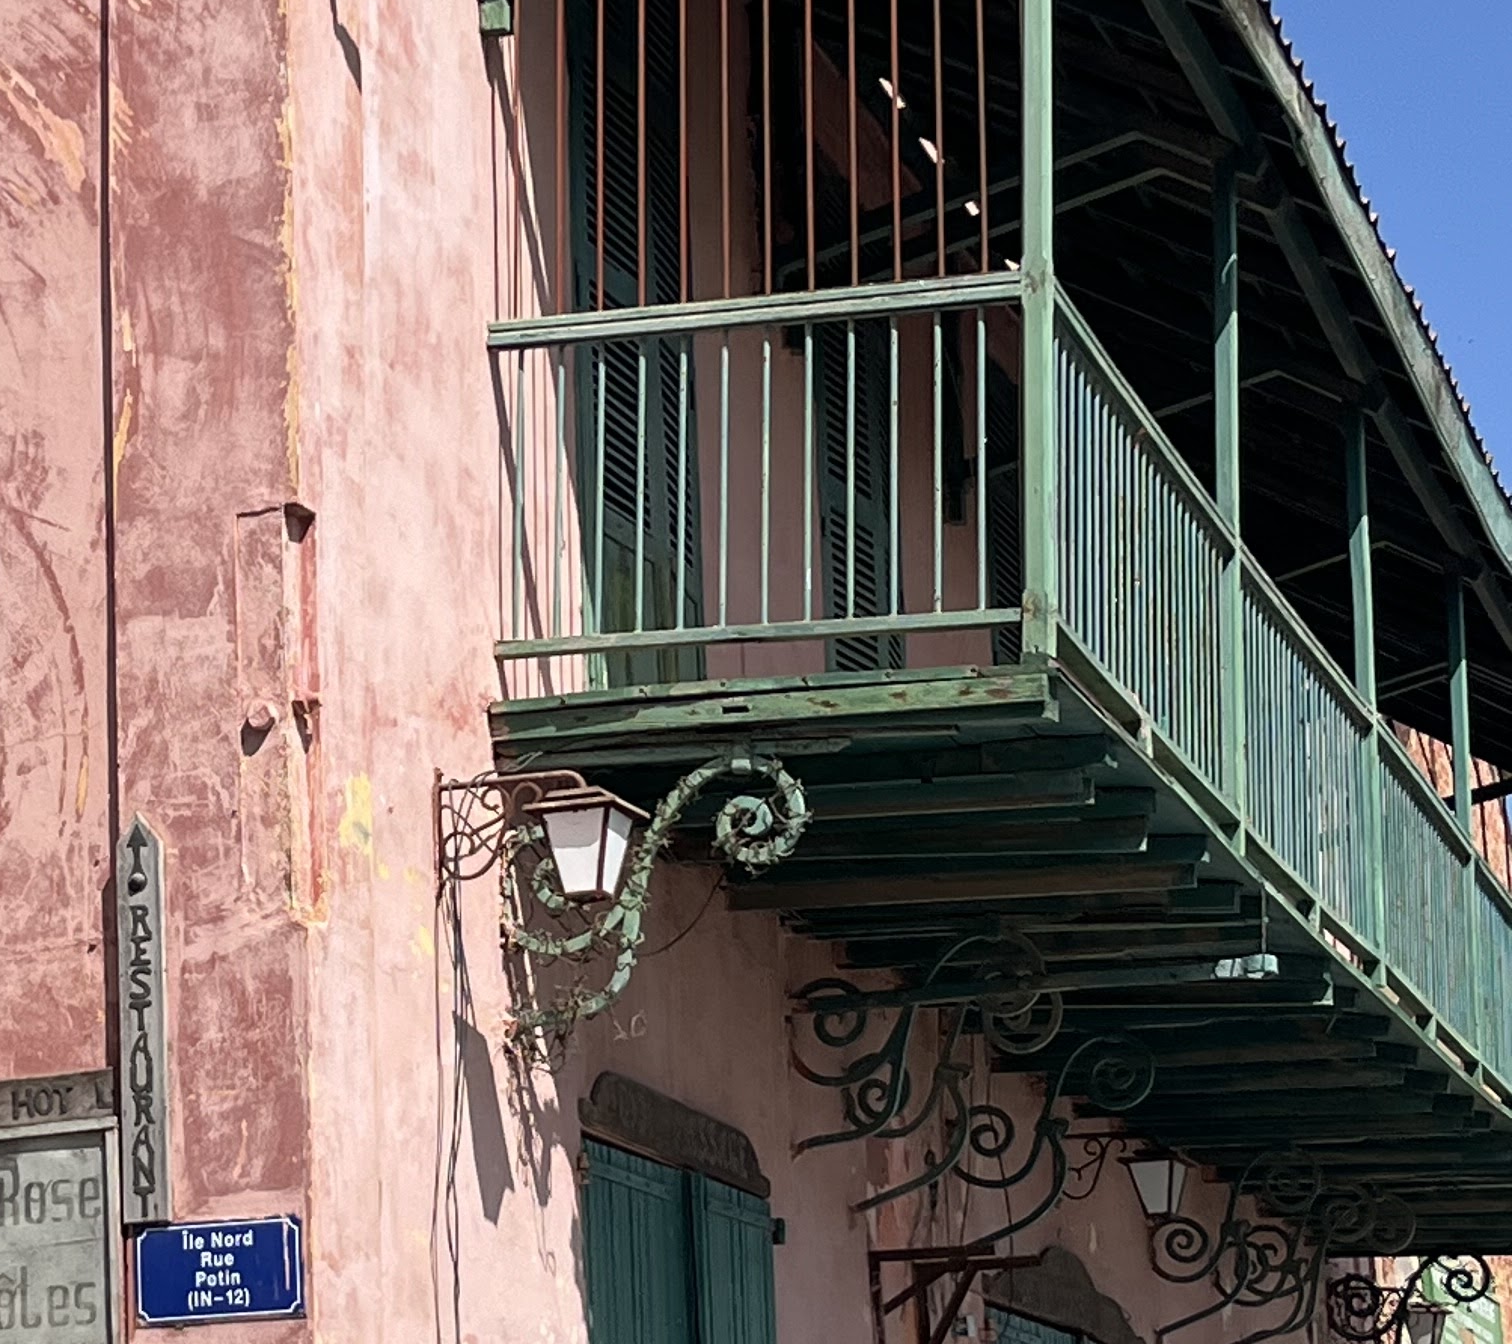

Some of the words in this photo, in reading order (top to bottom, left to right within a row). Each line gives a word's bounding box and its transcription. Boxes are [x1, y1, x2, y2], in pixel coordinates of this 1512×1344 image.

[128, 904, 156, 1218] RESTAURANT
[181, 1229, 205, 1251] Île
[210, 1228, 254, 1249] Nord
[200, 1251, 235, 1268] Rue
[195, 1269, 242, 1288] Potin
[188, 1287, 251, 1312] (IN-12)
